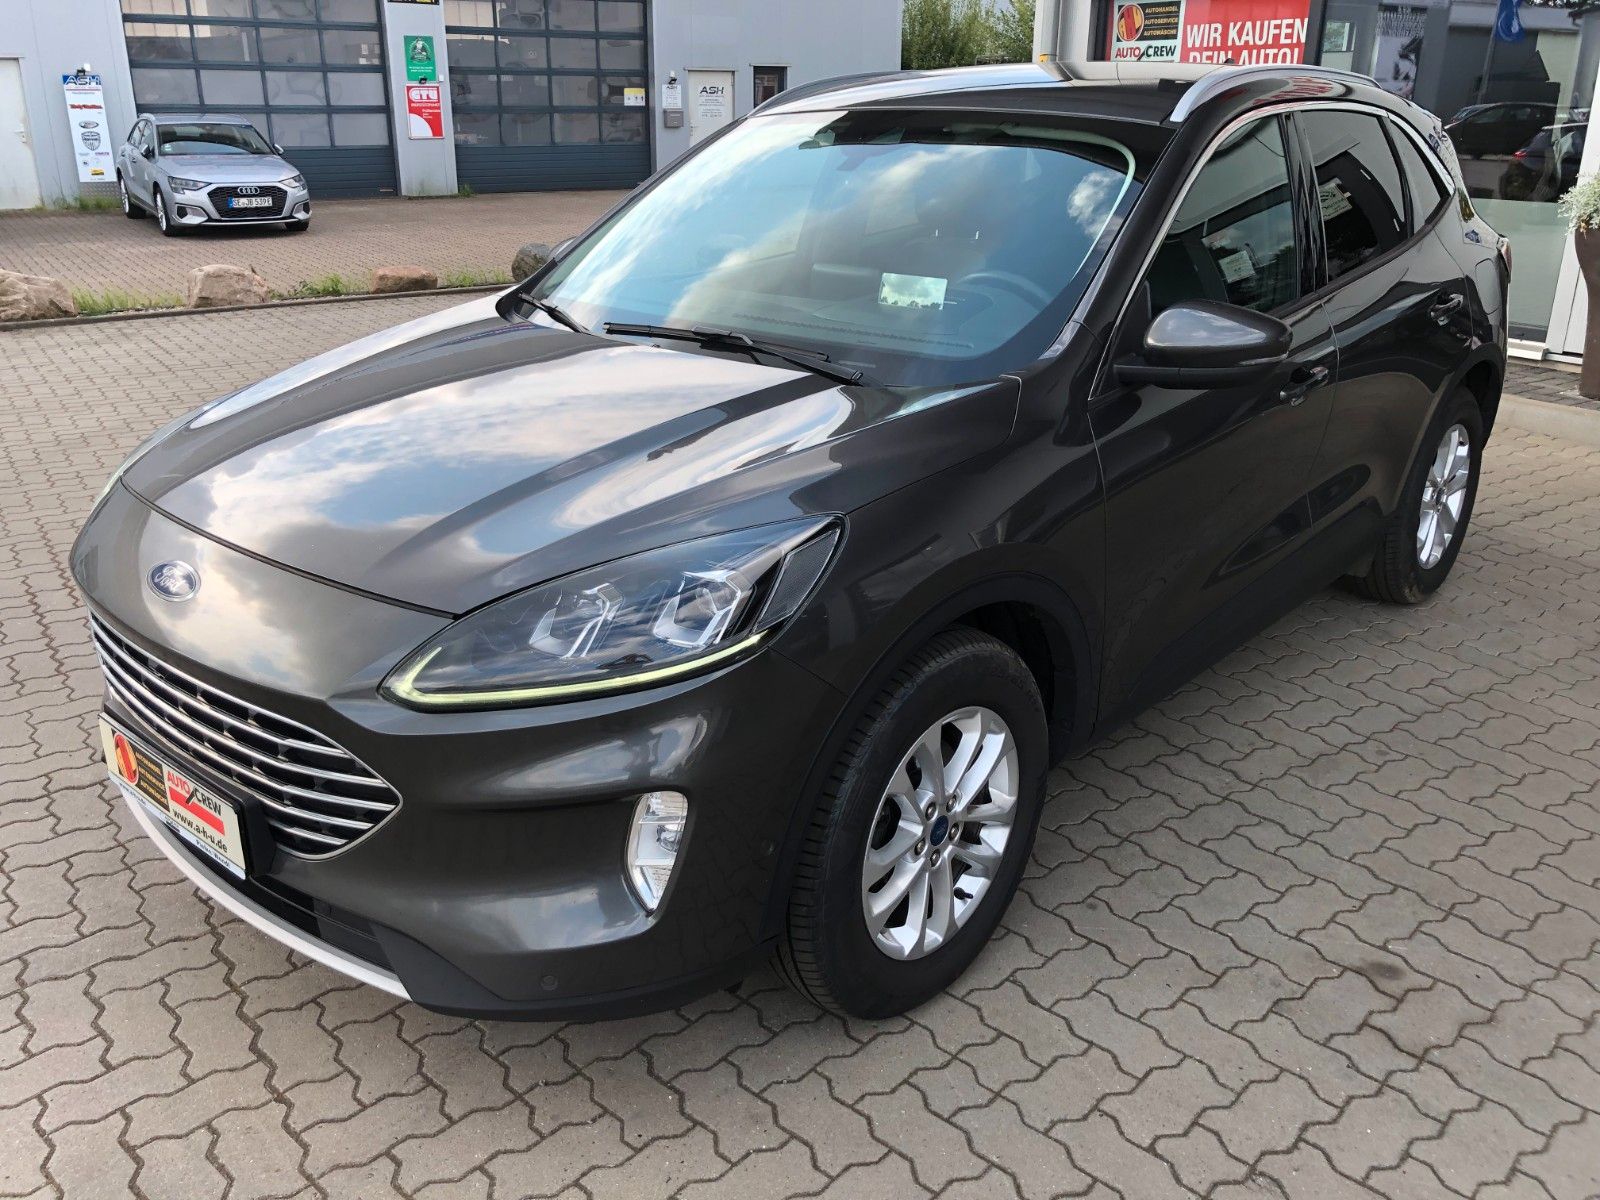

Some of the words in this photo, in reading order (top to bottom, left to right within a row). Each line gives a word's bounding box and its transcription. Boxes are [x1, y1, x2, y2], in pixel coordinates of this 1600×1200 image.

[1186, 23, 1223, 48] WIR
[1227, 18, 1309, 46] KAUFEN
[65, 76, 102, 85] ASH
[700, 86, 725, 95] ASH
[173, 808, 228, 854] www.a-h-u.de
